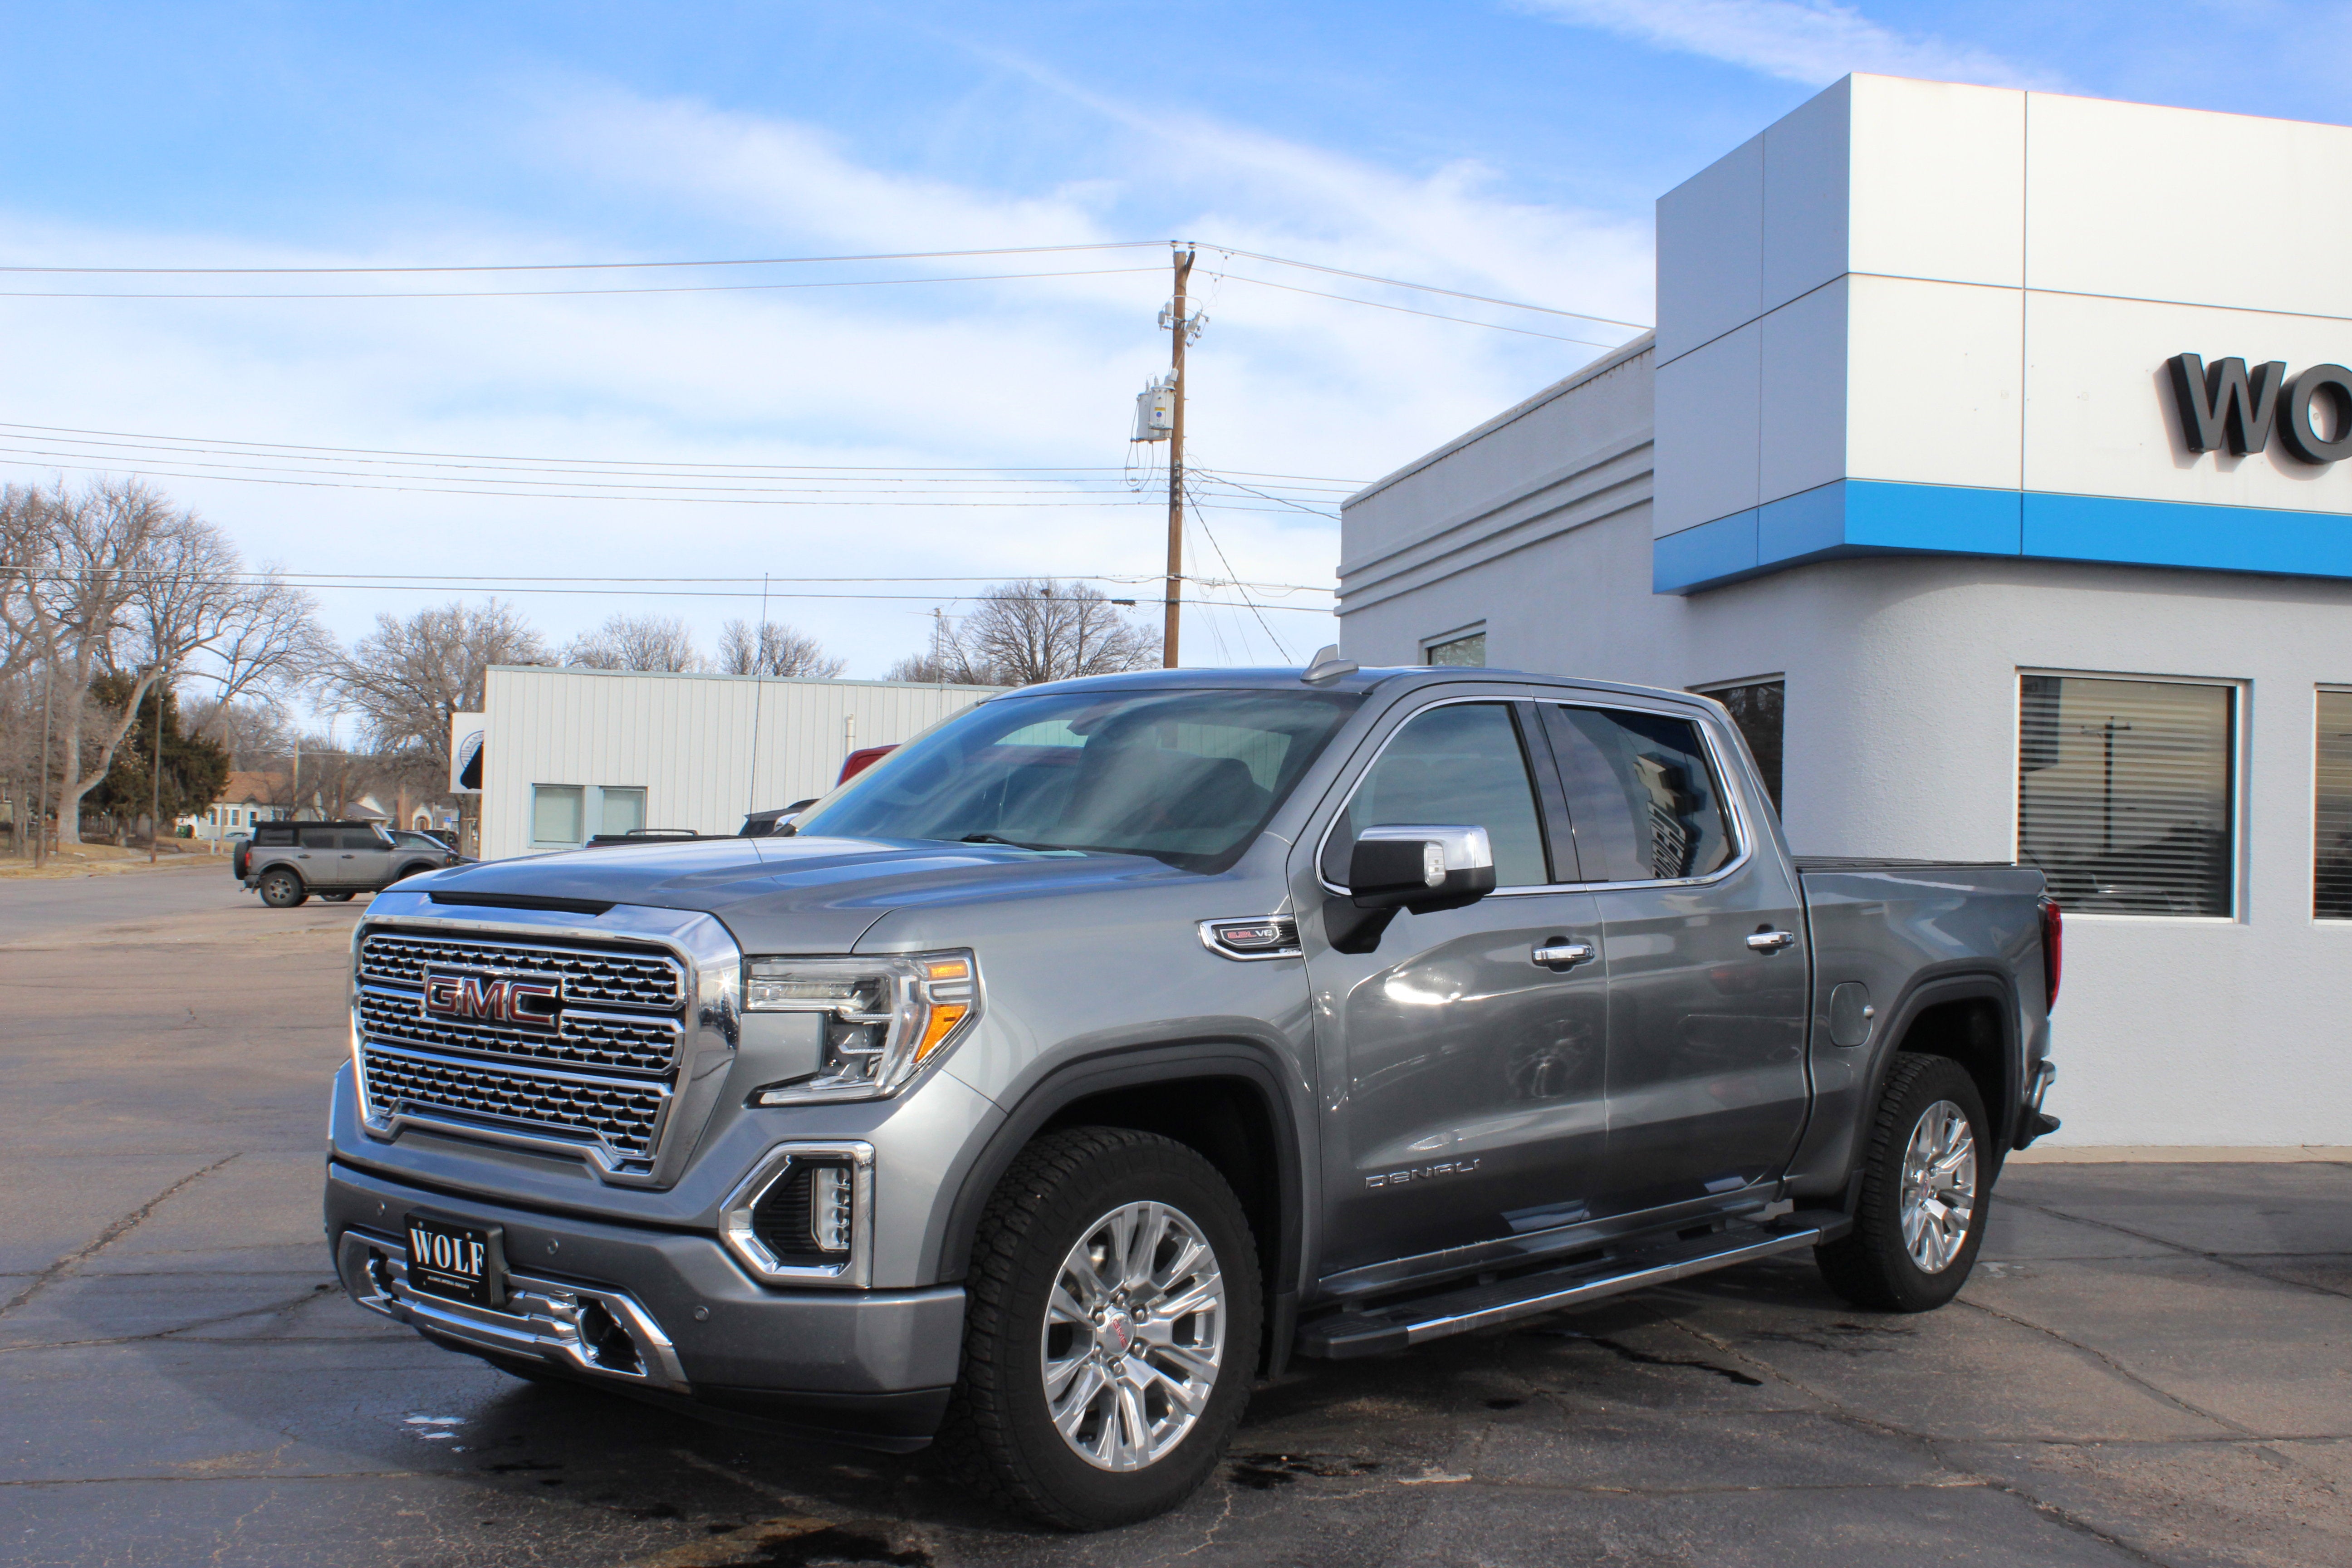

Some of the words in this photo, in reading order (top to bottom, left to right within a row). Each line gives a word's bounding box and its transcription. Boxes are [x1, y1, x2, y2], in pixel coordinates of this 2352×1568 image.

[2167, 353, 2352, 465] WO
[426, 975, 558, 1028] GMC
[1365, 1158, 1480, 1190] DENALI
[410, 1228, 484, 1276] WOLF
[1112, 1318, 1128, 1348] GMC
